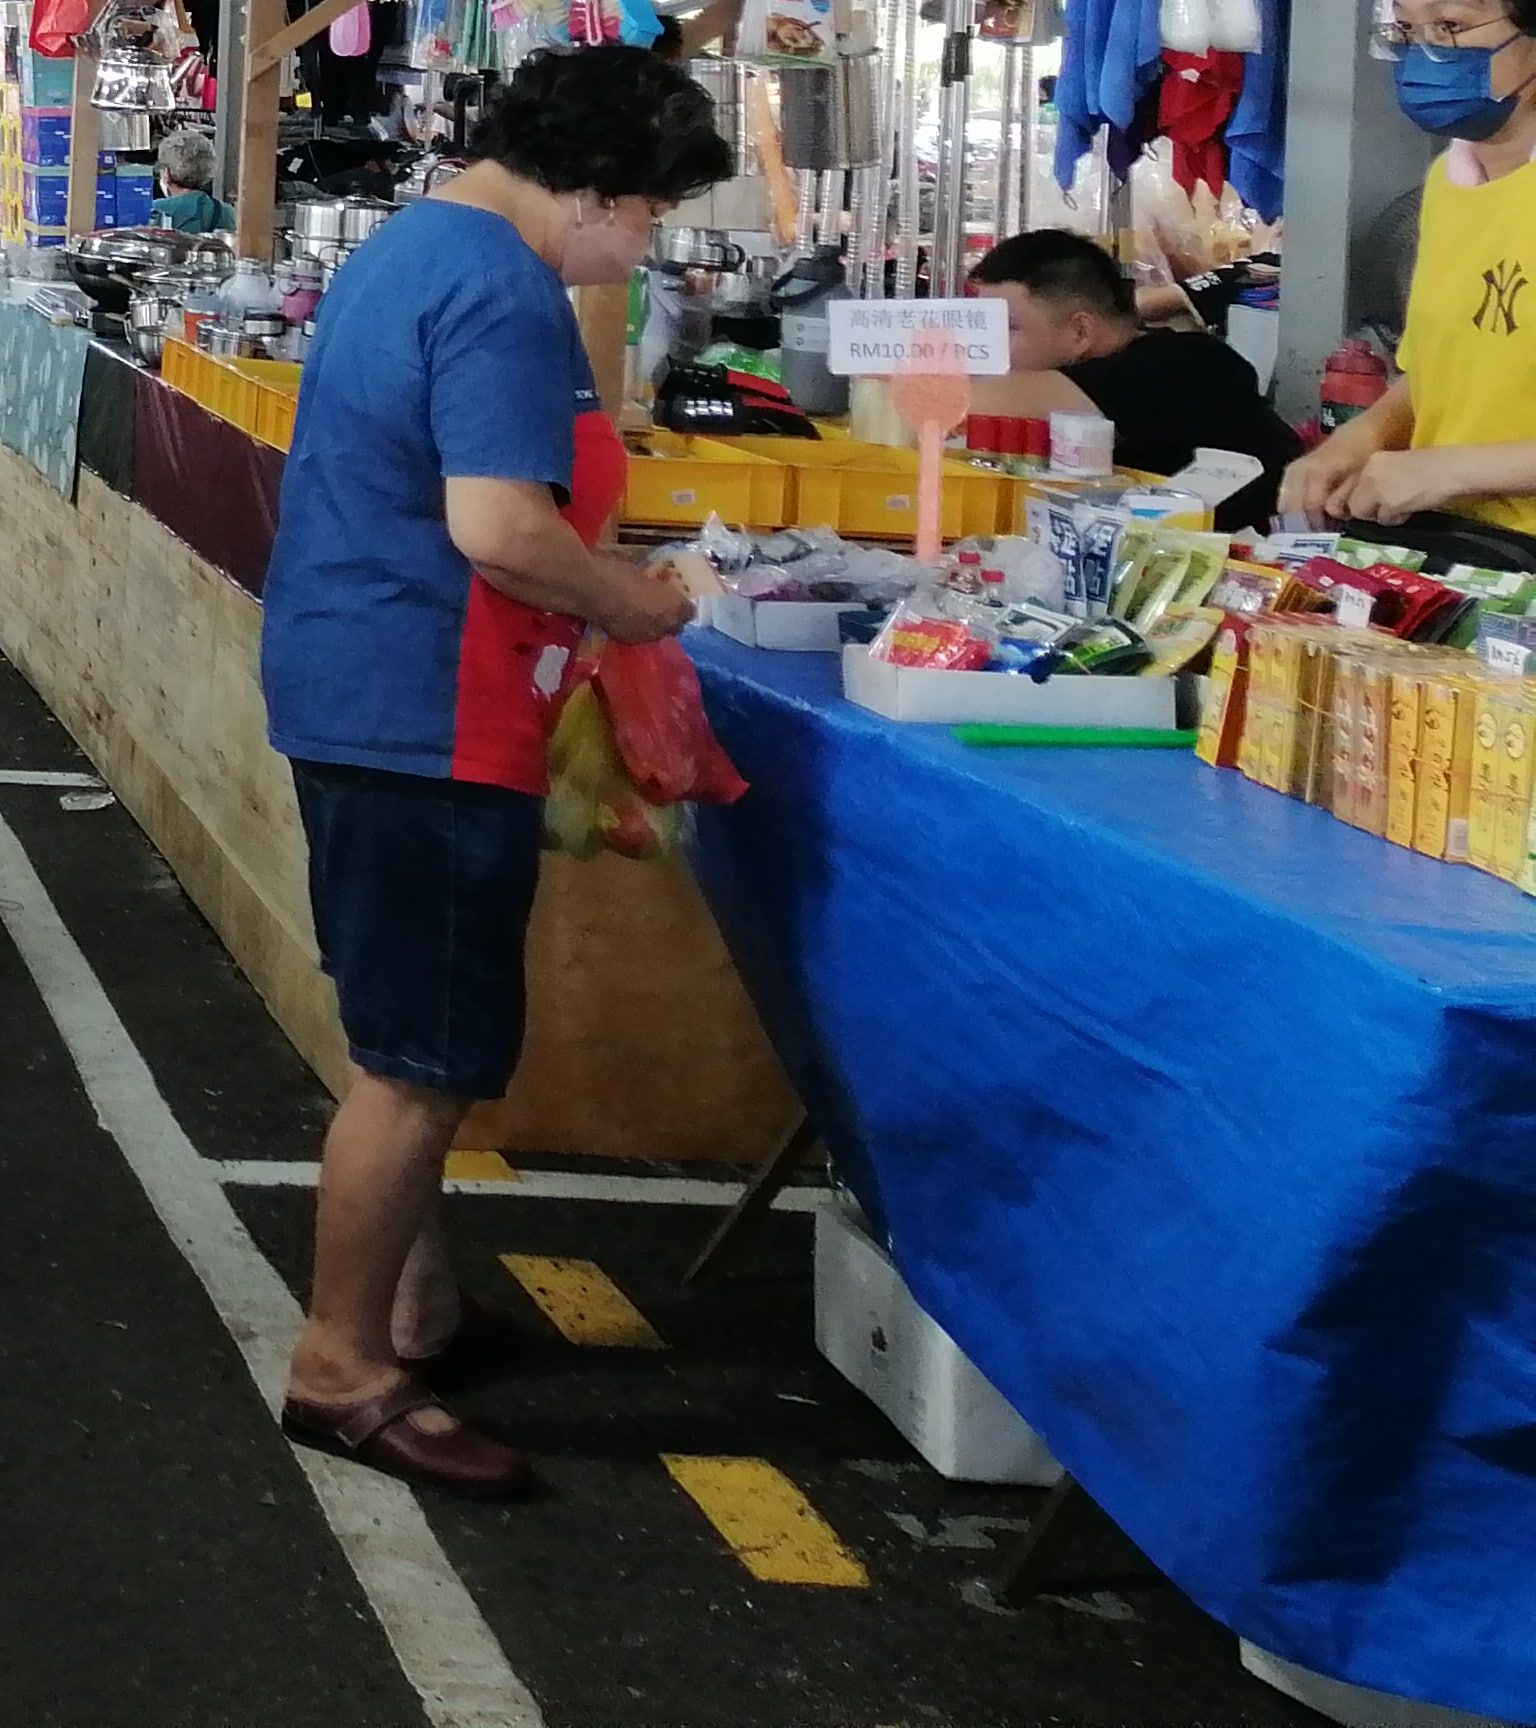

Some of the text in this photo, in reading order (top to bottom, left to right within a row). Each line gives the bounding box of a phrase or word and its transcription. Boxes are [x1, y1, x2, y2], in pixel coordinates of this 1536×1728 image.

[850, 309, 988, 330] 高清老花眼镜
[849, 342, 935, 360] RM10.00
[954, 343, 990, 360] PCS
